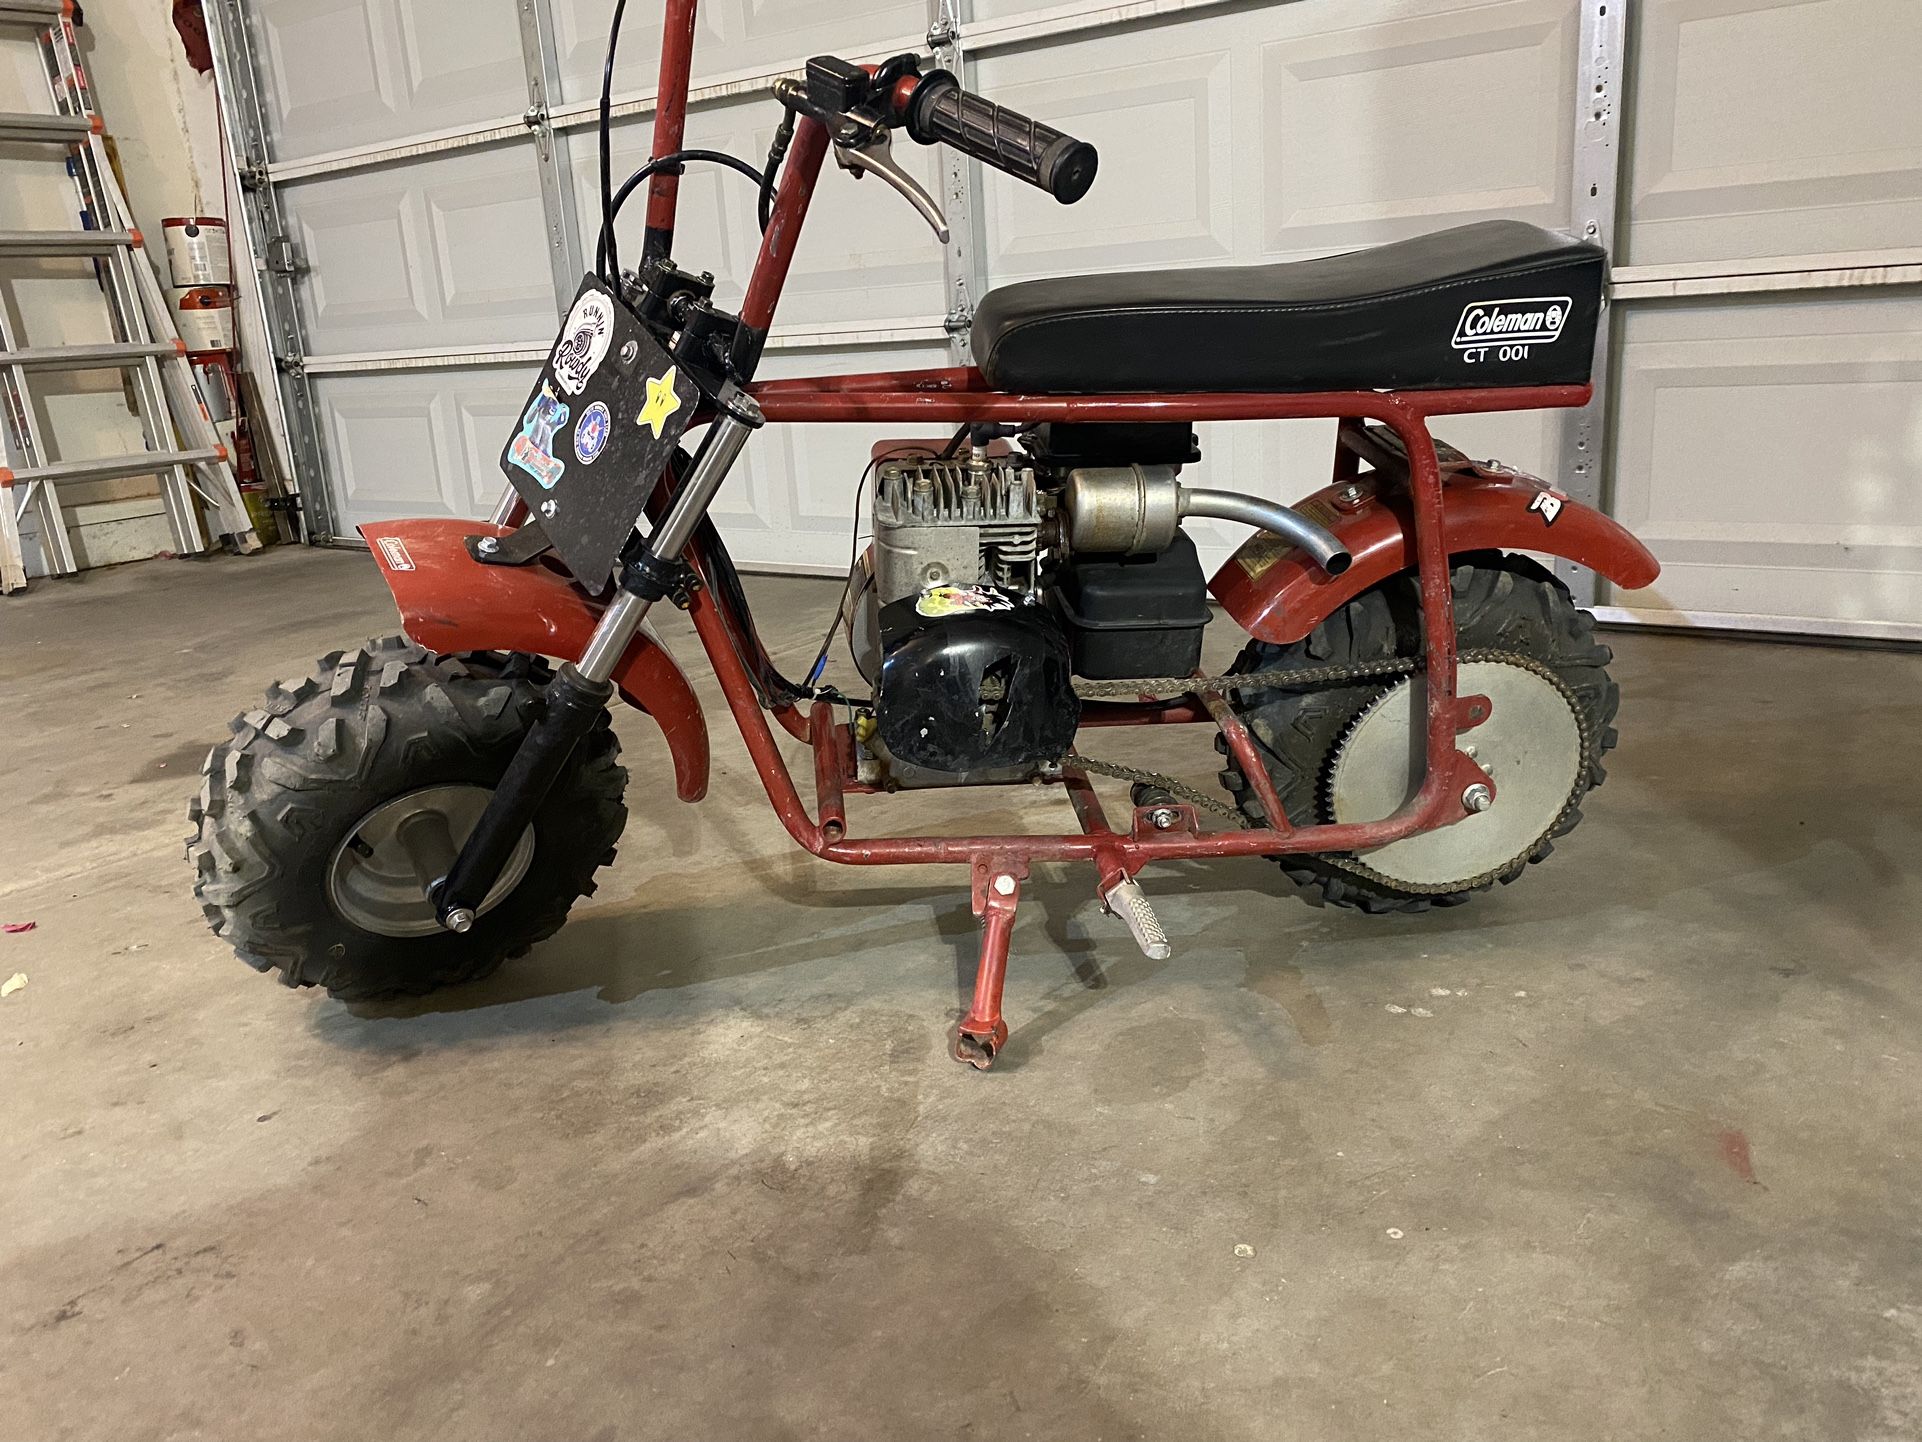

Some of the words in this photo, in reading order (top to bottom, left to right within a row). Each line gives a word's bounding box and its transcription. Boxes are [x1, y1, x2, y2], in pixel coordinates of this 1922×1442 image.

[583, 305, 604, 335] RUNNIN
[1464, 306, 1545, 336] Coleman
[555, 339, 592, 390] Rowdy
[1463, 347, 1489, 364] CT
